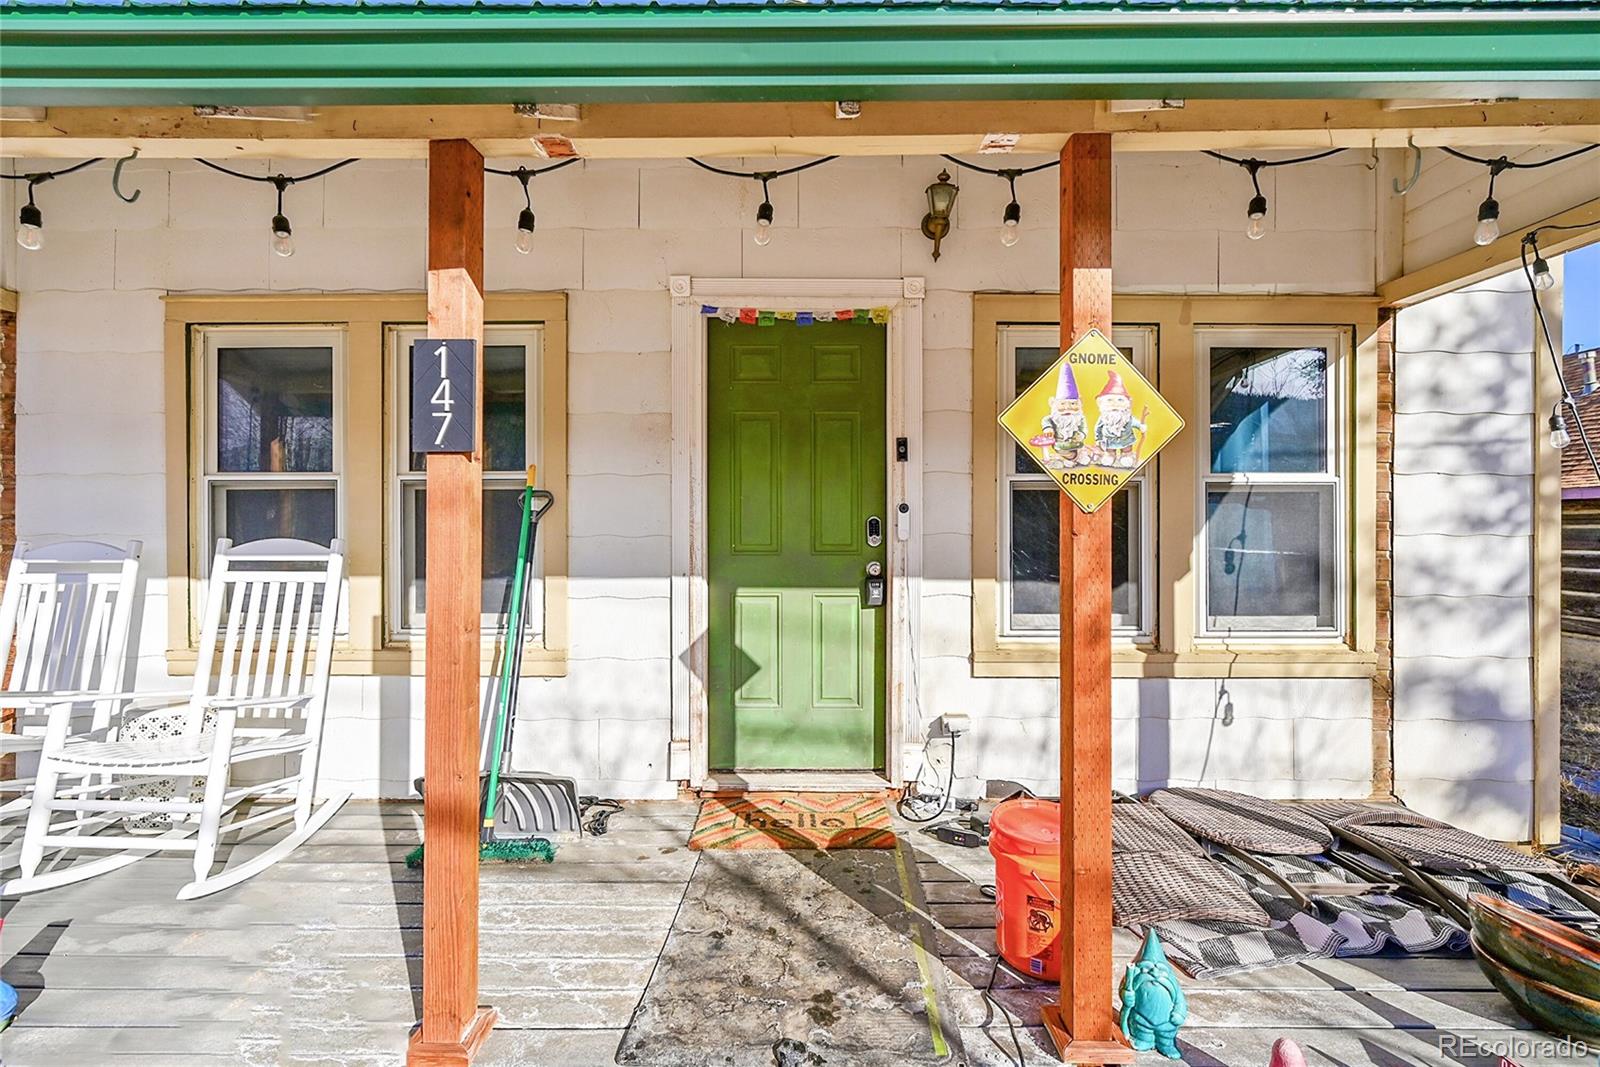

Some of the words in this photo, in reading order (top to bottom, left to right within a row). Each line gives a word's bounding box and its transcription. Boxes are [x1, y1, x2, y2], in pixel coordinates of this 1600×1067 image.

[1069, 353, 1117, 365] GNOME
[430, 345, 455, 445] 147
[1062, 472, 1119, 486] CROSSING
[744, 811, 846, 829] hello
